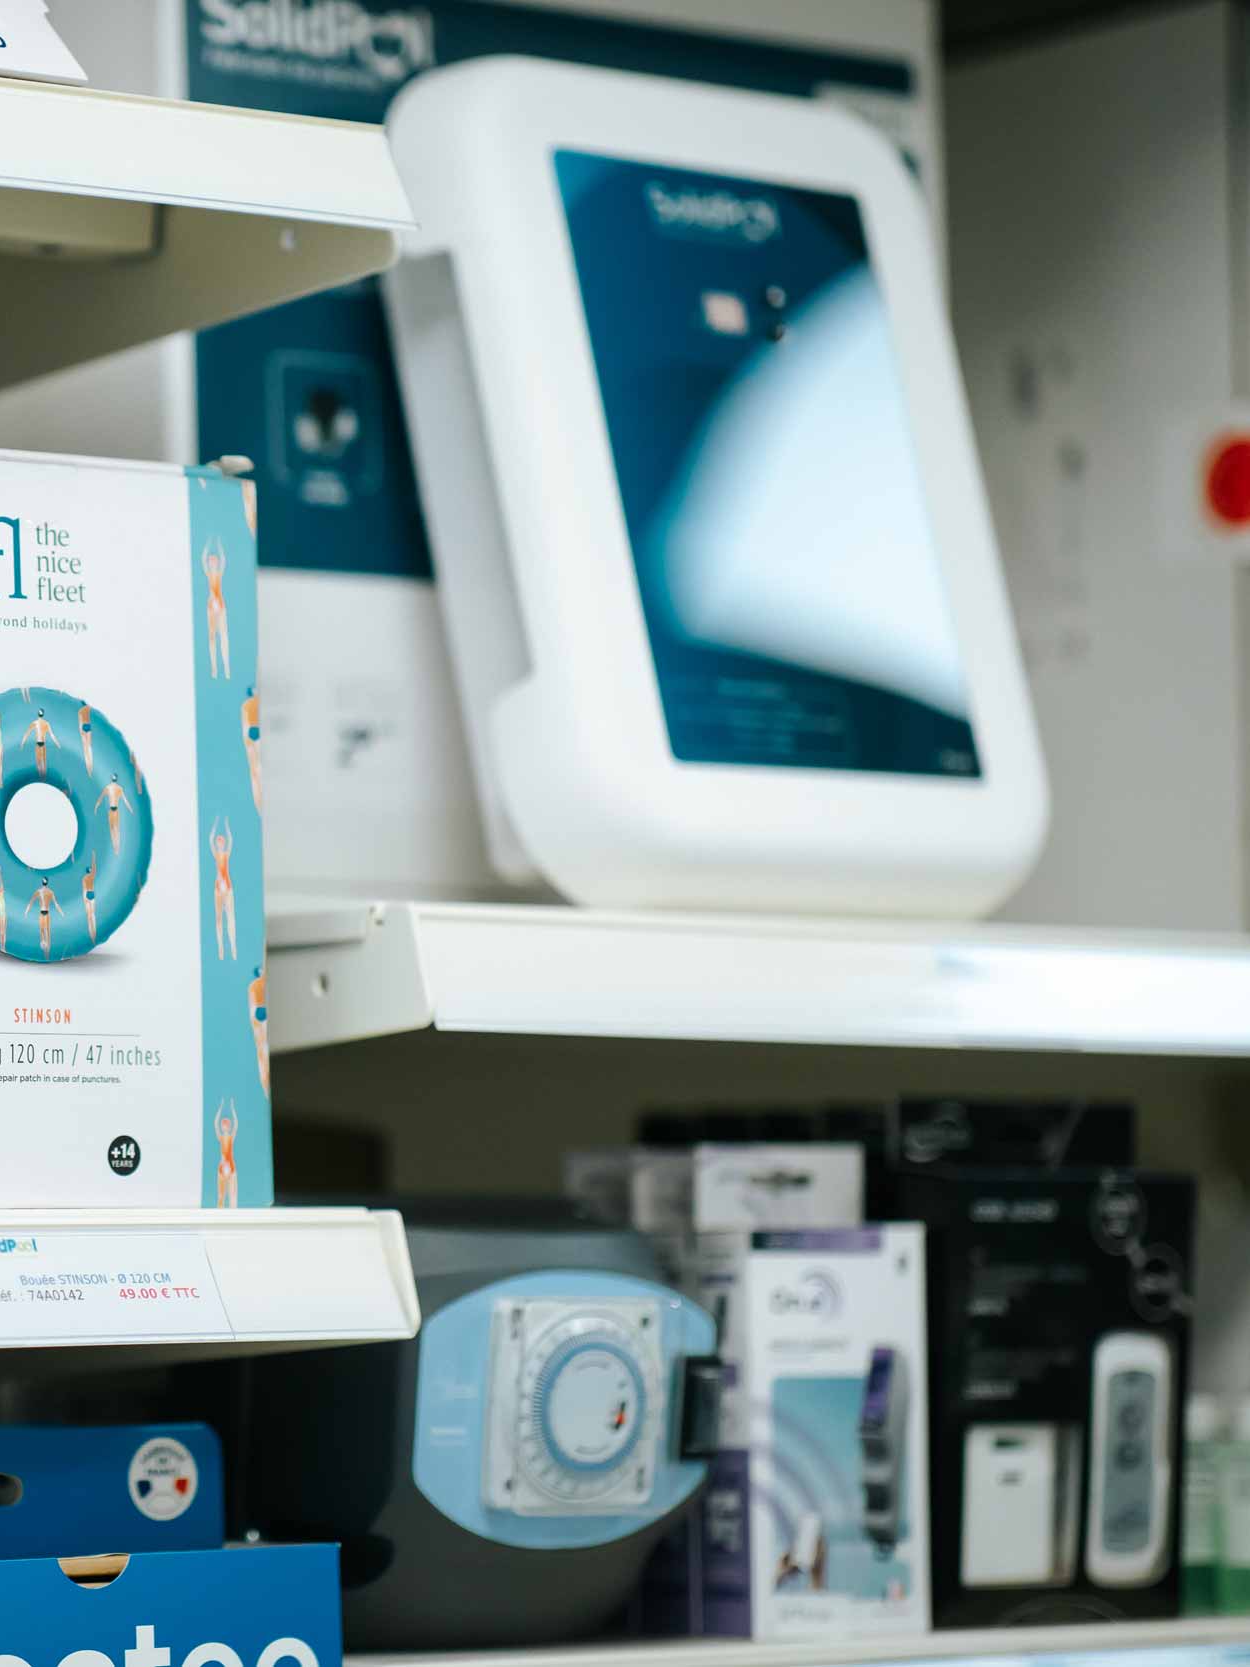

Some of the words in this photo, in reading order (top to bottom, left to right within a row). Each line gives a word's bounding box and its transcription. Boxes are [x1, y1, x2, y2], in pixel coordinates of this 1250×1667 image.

[36, 522, 70, 547] the
[36, 551, 82, 575] nice
[36, 576, 86, 603] fleet
[32, 616, 89, 633] holidays
[14, 1007, 73, 1024] STINSON
[10, 1043, 35, 1064] 120
[42, 1047, 64, 1064] cm
[71, 1043, 79, 1067] /
[86, 1045, 103, 1064] 47
[110, 1045, 162, 1066] inches
[19, 1074, 42, 1083] patch
[71, 1075, 80, 1083] of
[81, 1076, 121, 1084] punctures.
[111, 1143, 136, 1159] +14
[111, 1160, 133, 1168] YEARS
[19, 1274, 55, 1286] Bouée
[57, 1274, 108, 1285] STINSON
[130, 1273, 151, 1284] 120
[153, 1273, 171, 1283] CM
[29, 1289, 85, 1301] 74A0142
[118, 1287, 159, 1300] 49.00
[161, 1287, 170, 1299] €
[172, 1287, 200, 1298] TTC
